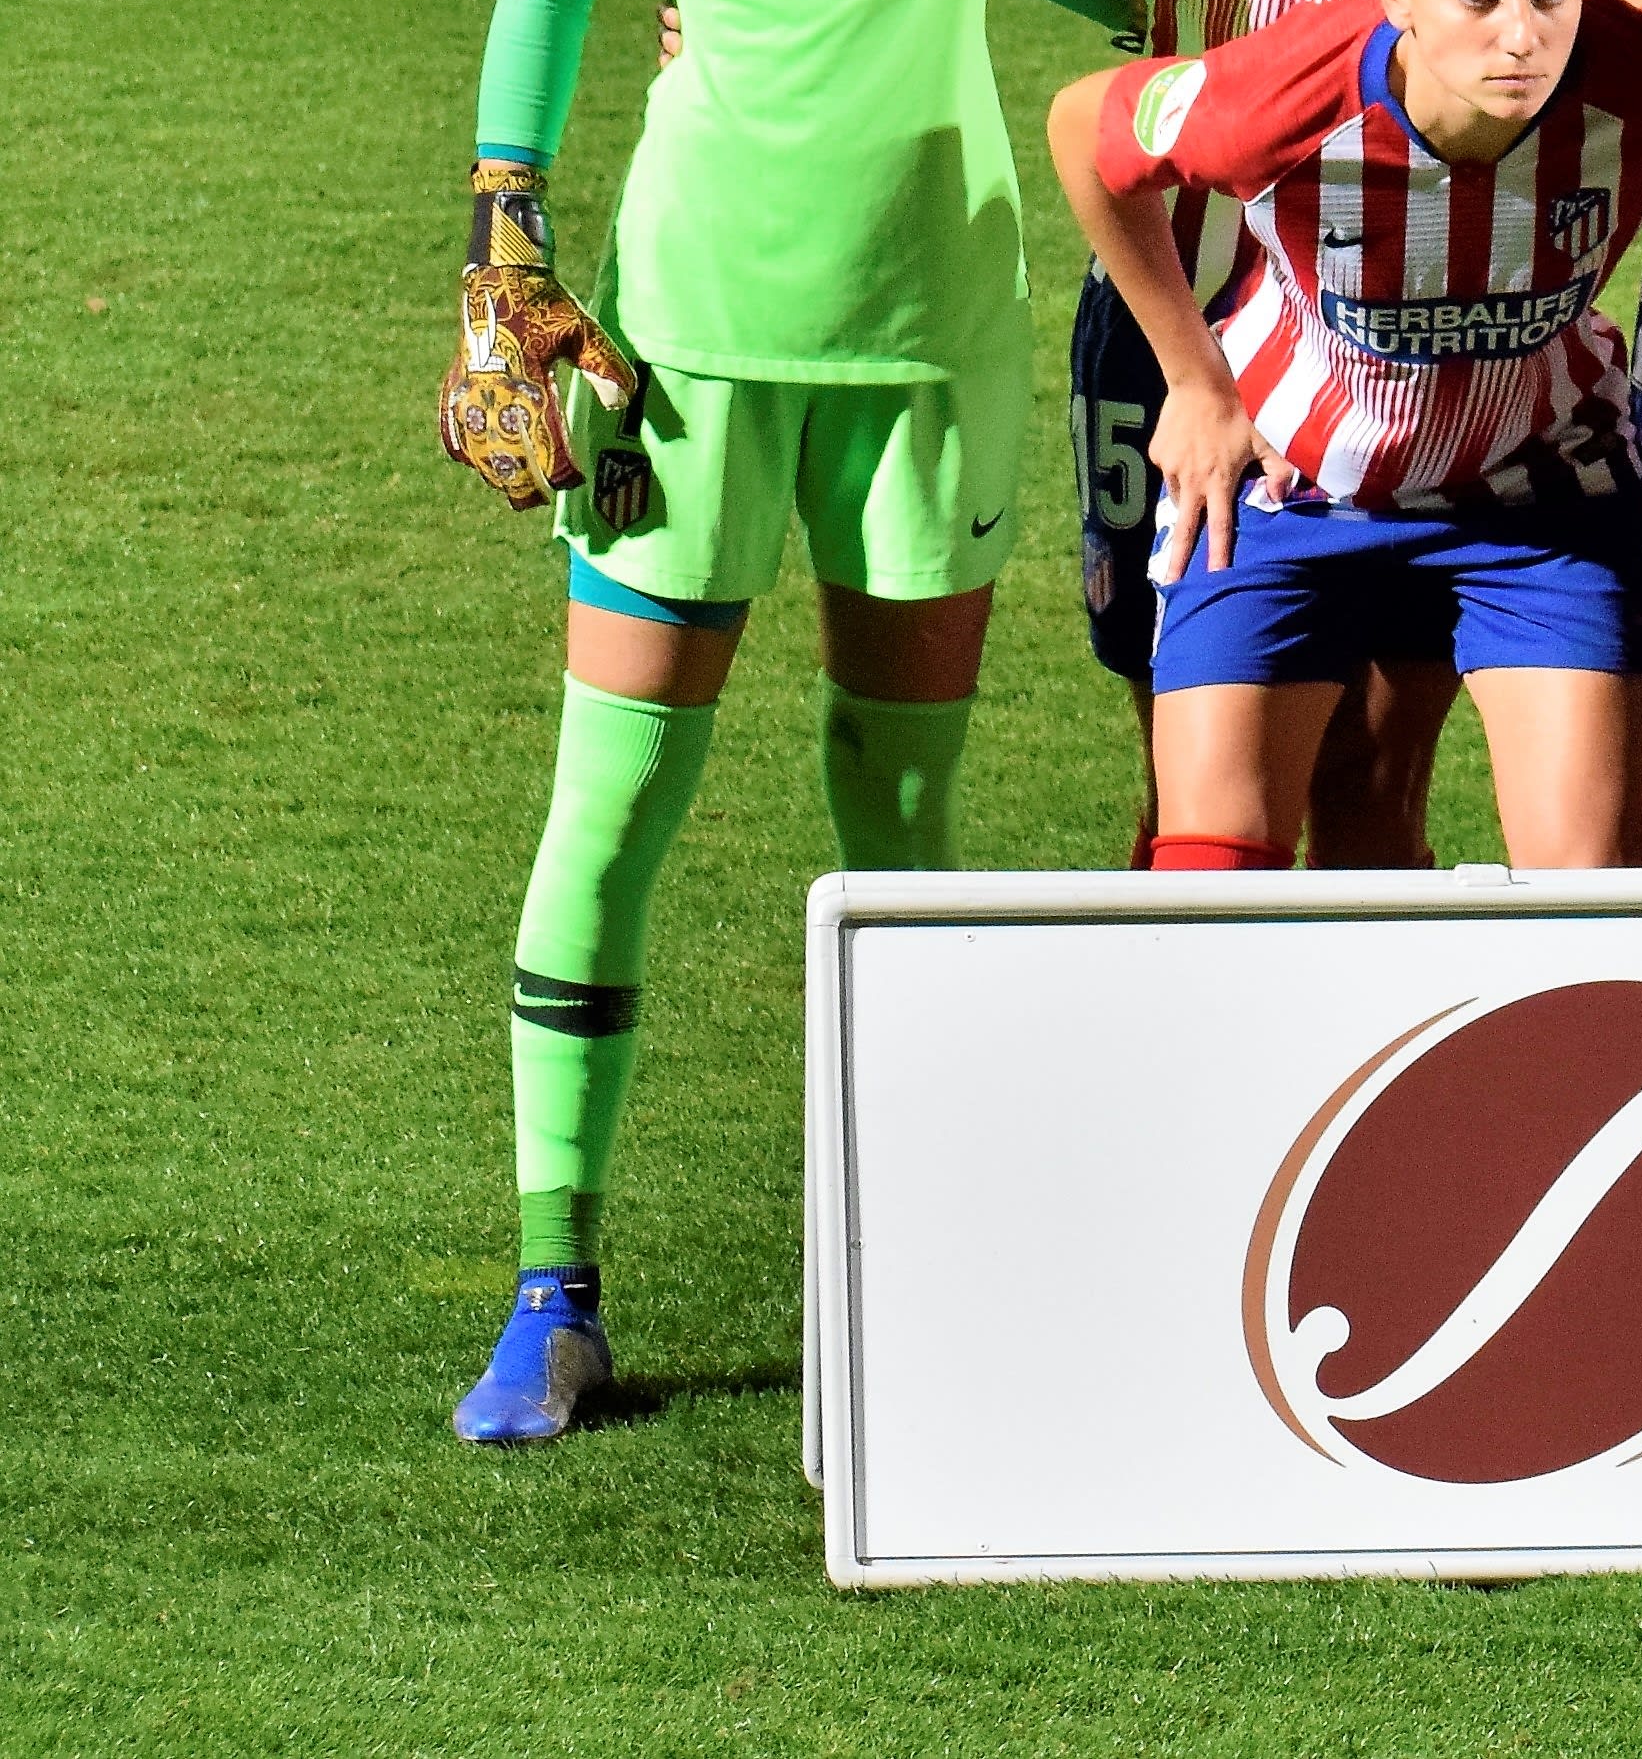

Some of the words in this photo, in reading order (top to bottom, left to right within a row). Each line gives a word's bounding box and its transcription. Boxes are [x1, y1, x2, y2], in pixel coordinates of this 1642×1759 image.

[1335, 281, 1582, 332] HERBALIFE
[1336, 303, 1576, 357] NUTRITION
[1071, 393, 1147, 530] 15
